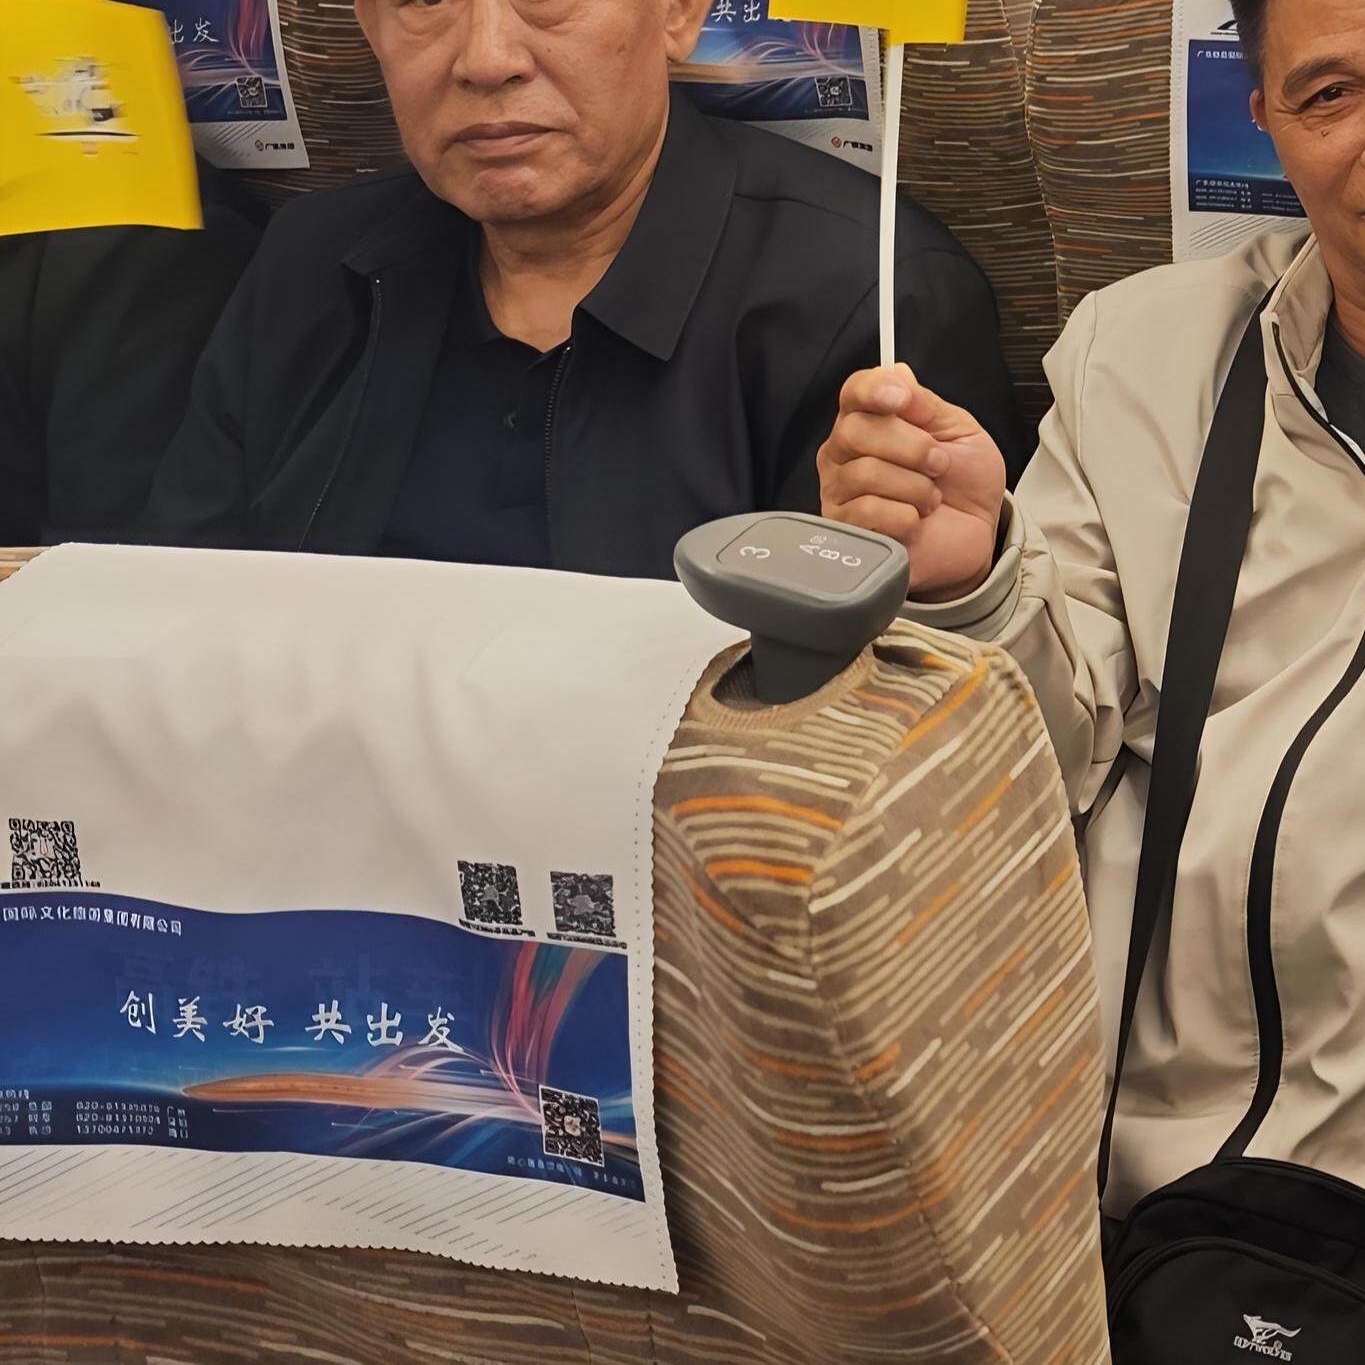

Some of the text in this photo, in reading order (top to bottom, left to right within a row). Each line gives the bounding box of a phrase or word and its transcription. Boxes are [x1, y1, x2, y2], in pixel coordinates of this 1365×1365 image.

[119, 990, 464, 1053] 创美好 共出发
